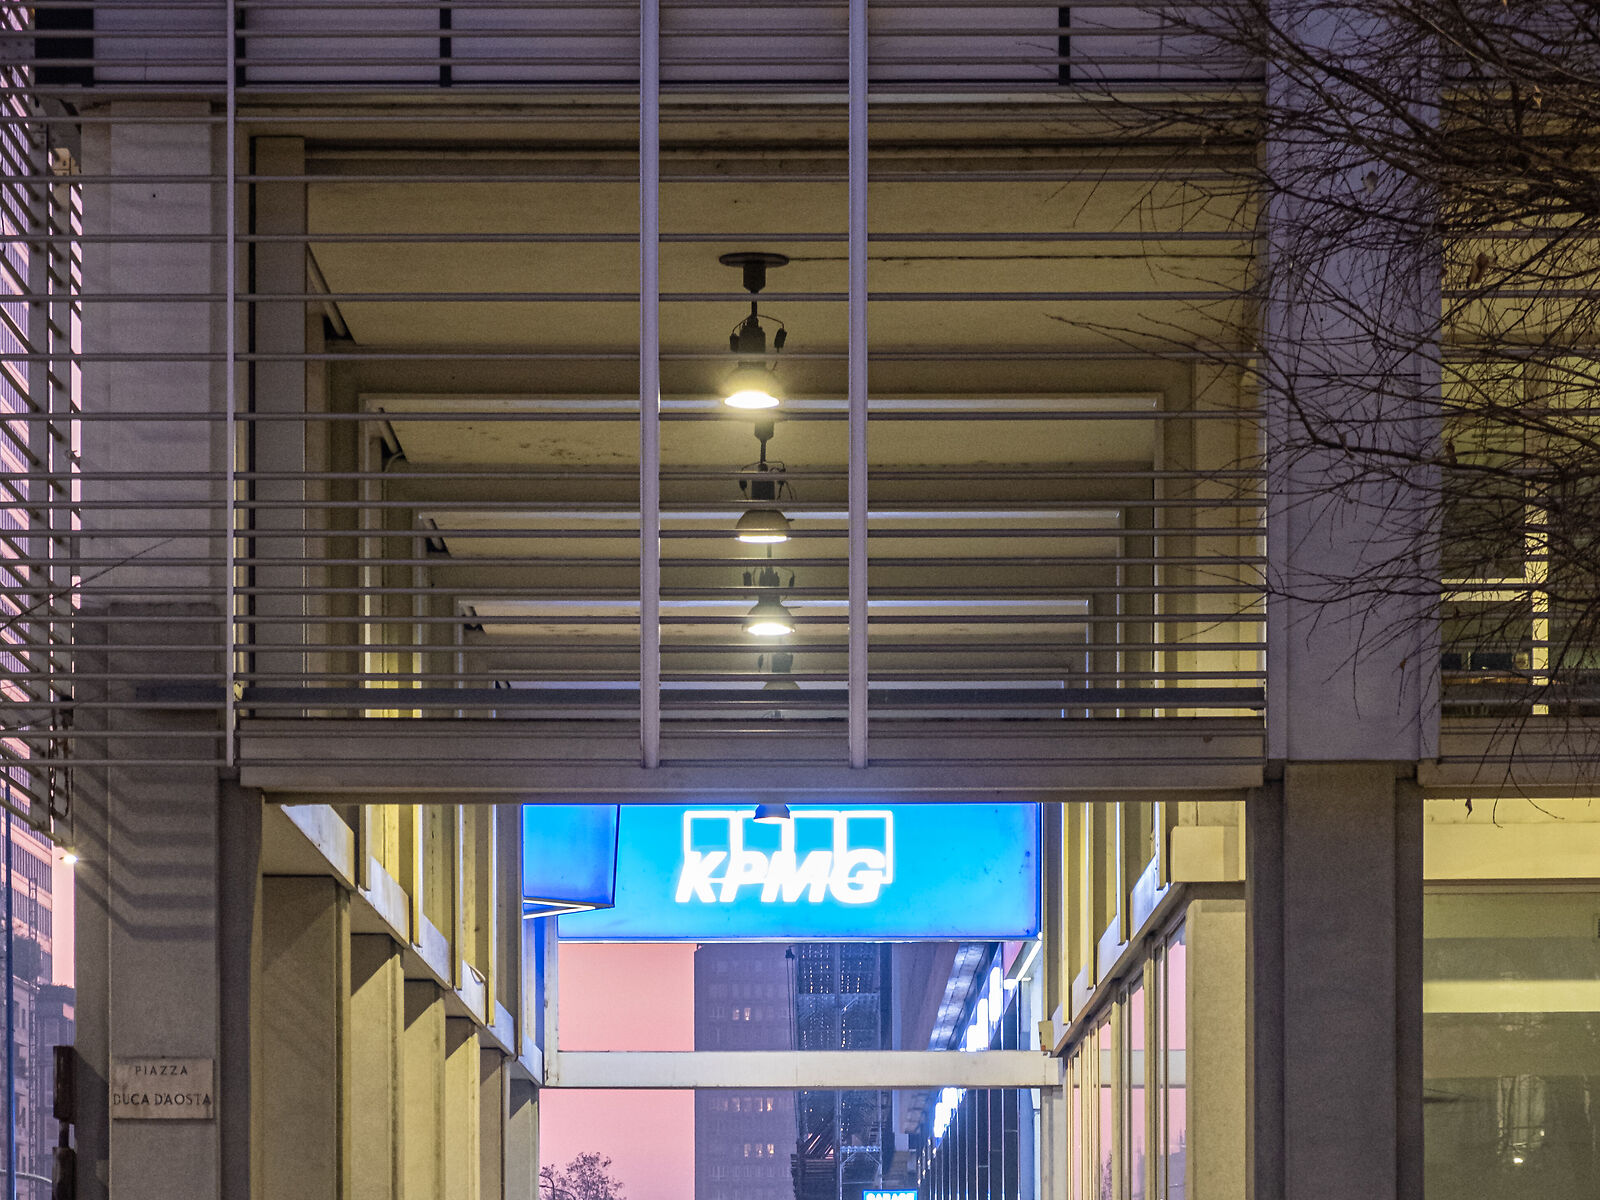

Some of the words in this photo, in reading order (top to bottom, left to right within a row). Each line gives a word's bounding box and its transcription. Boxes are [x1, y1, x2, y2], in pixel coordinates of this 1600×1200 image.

[675, 849, 887, 904] KPMG
[135, 1065, 188, 1076] PIAZZA
[113, 1093, 150, 1106] DUCA
[154, 1093, 212, 1106] D'AOSTA
